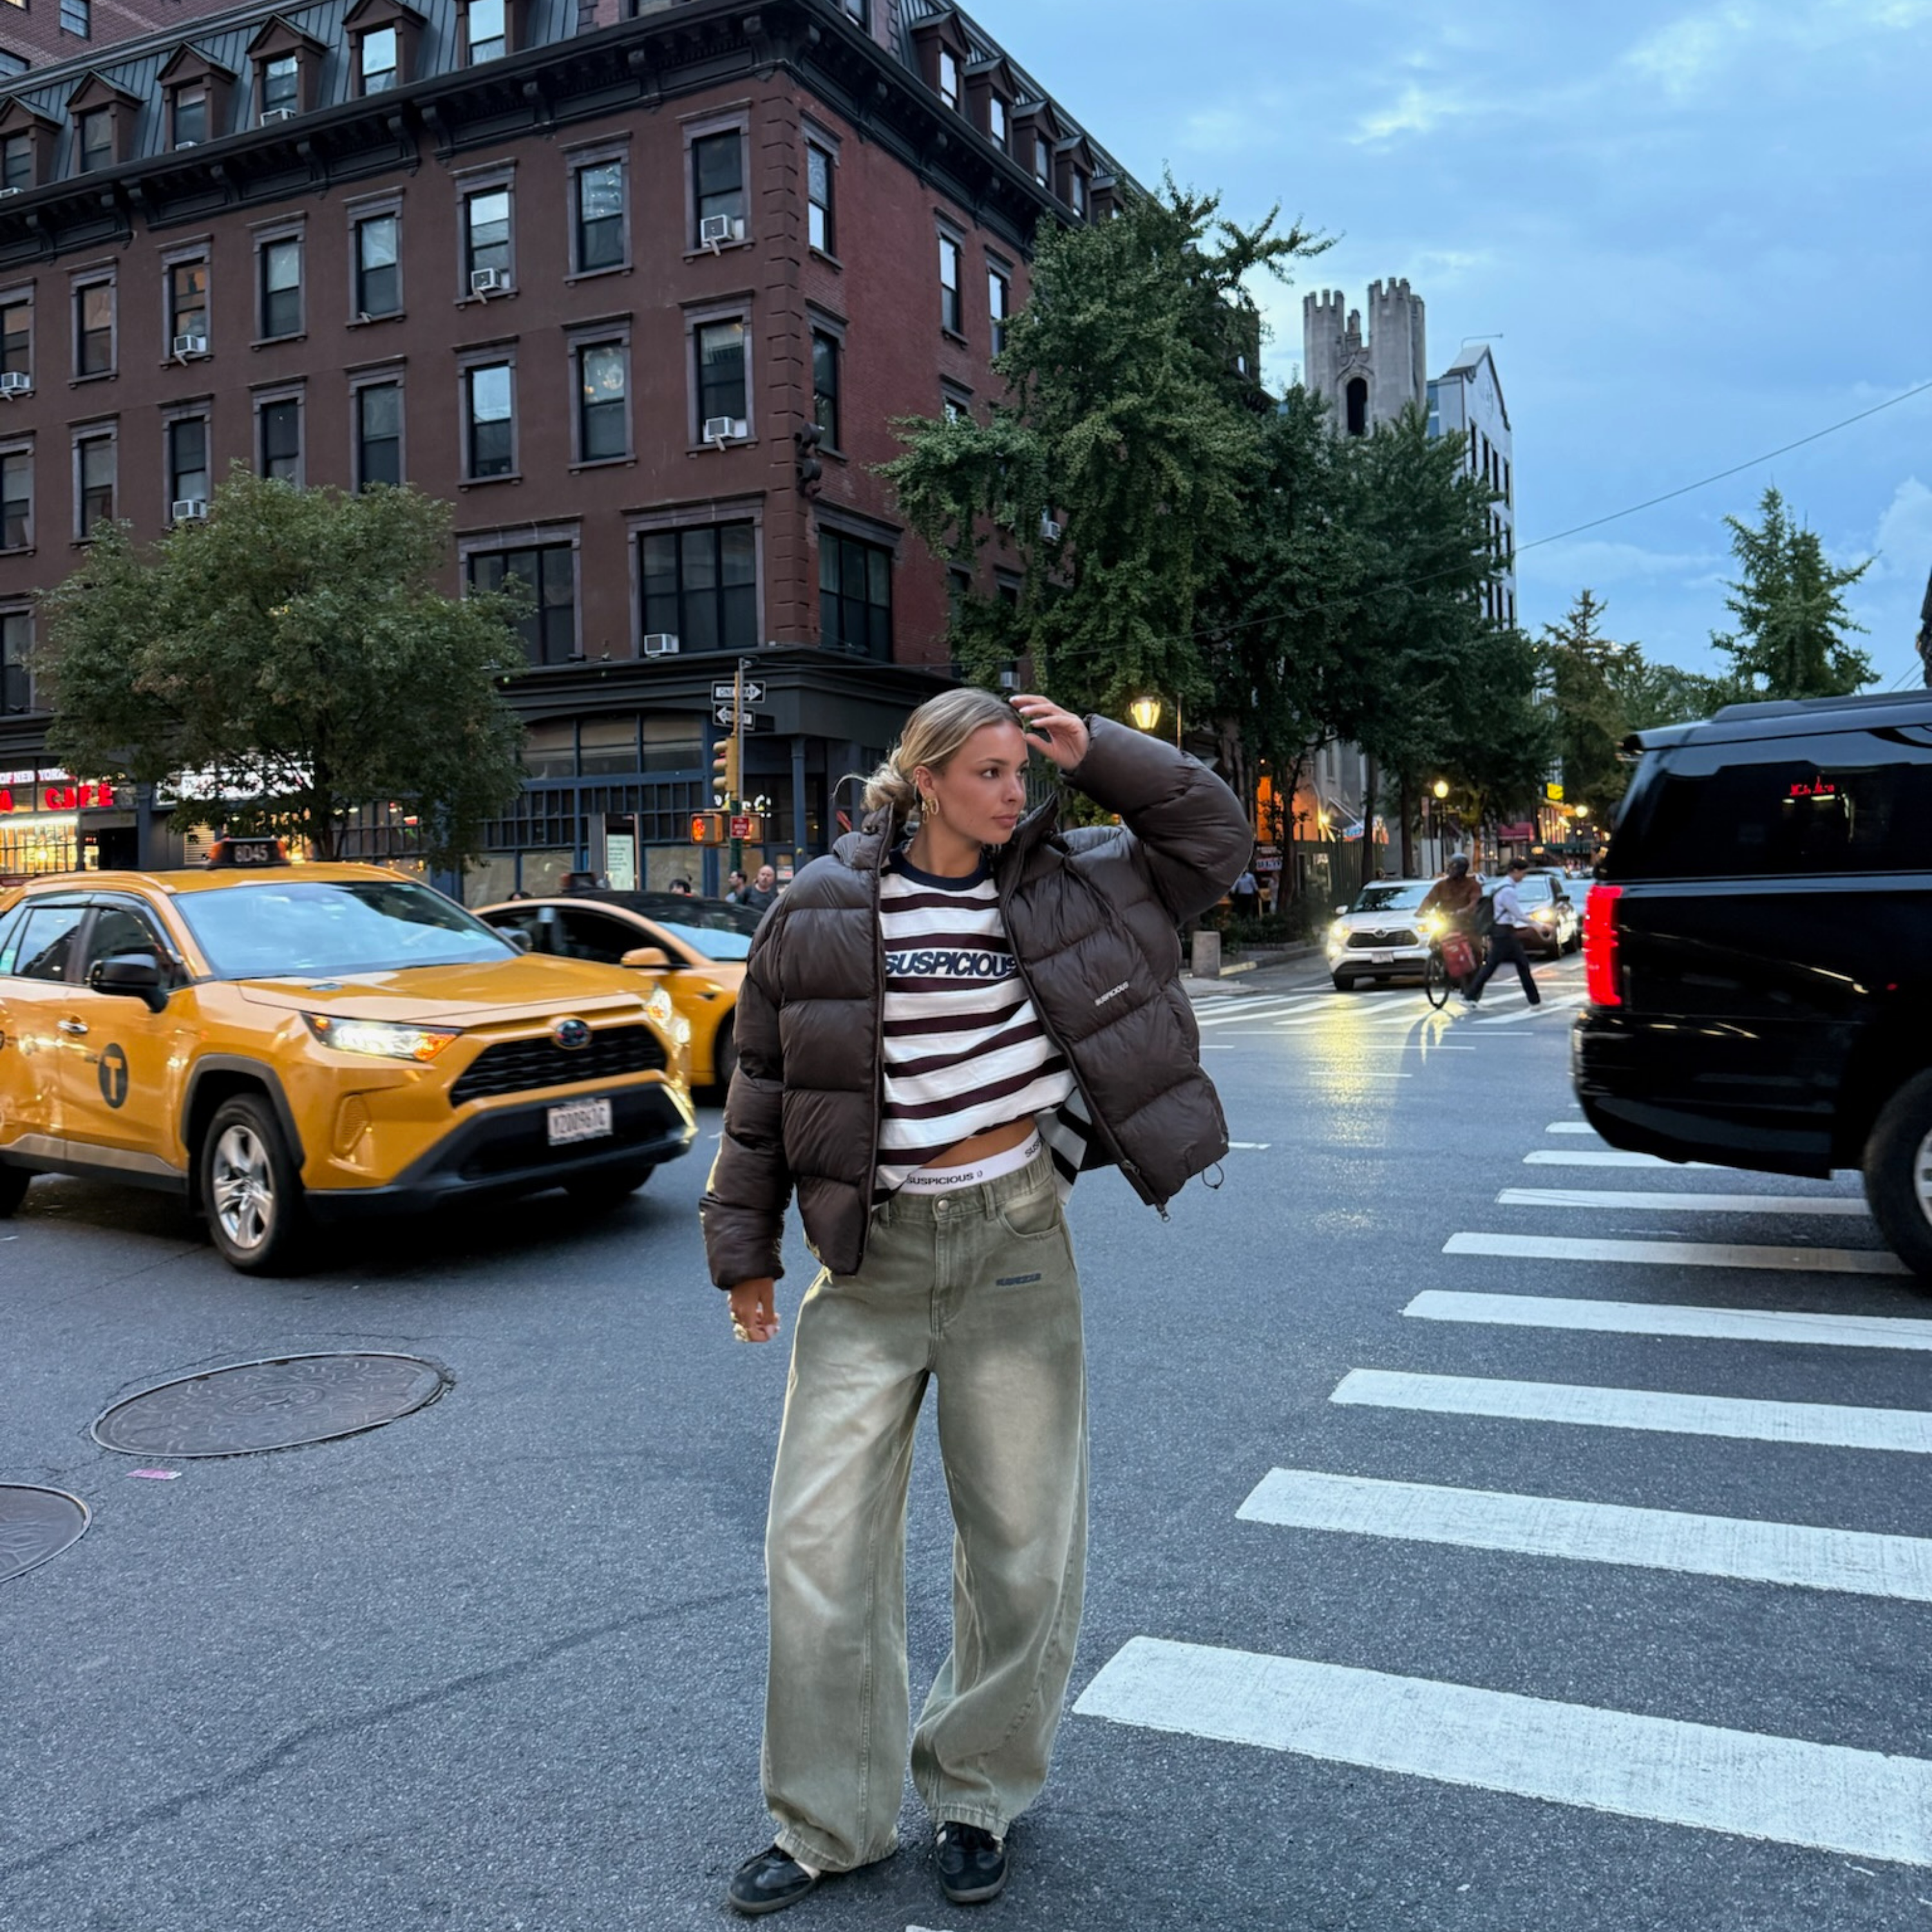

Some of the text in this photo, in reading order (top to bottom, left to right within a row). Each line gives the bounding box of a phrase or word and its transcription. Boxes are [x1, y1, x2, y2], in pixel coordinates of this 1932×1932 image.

[14, 770, 35, 783] NEW
[104, 1056, 122, 1100] T
[905, 1172, 974, 1186] SUSPICIOUS
